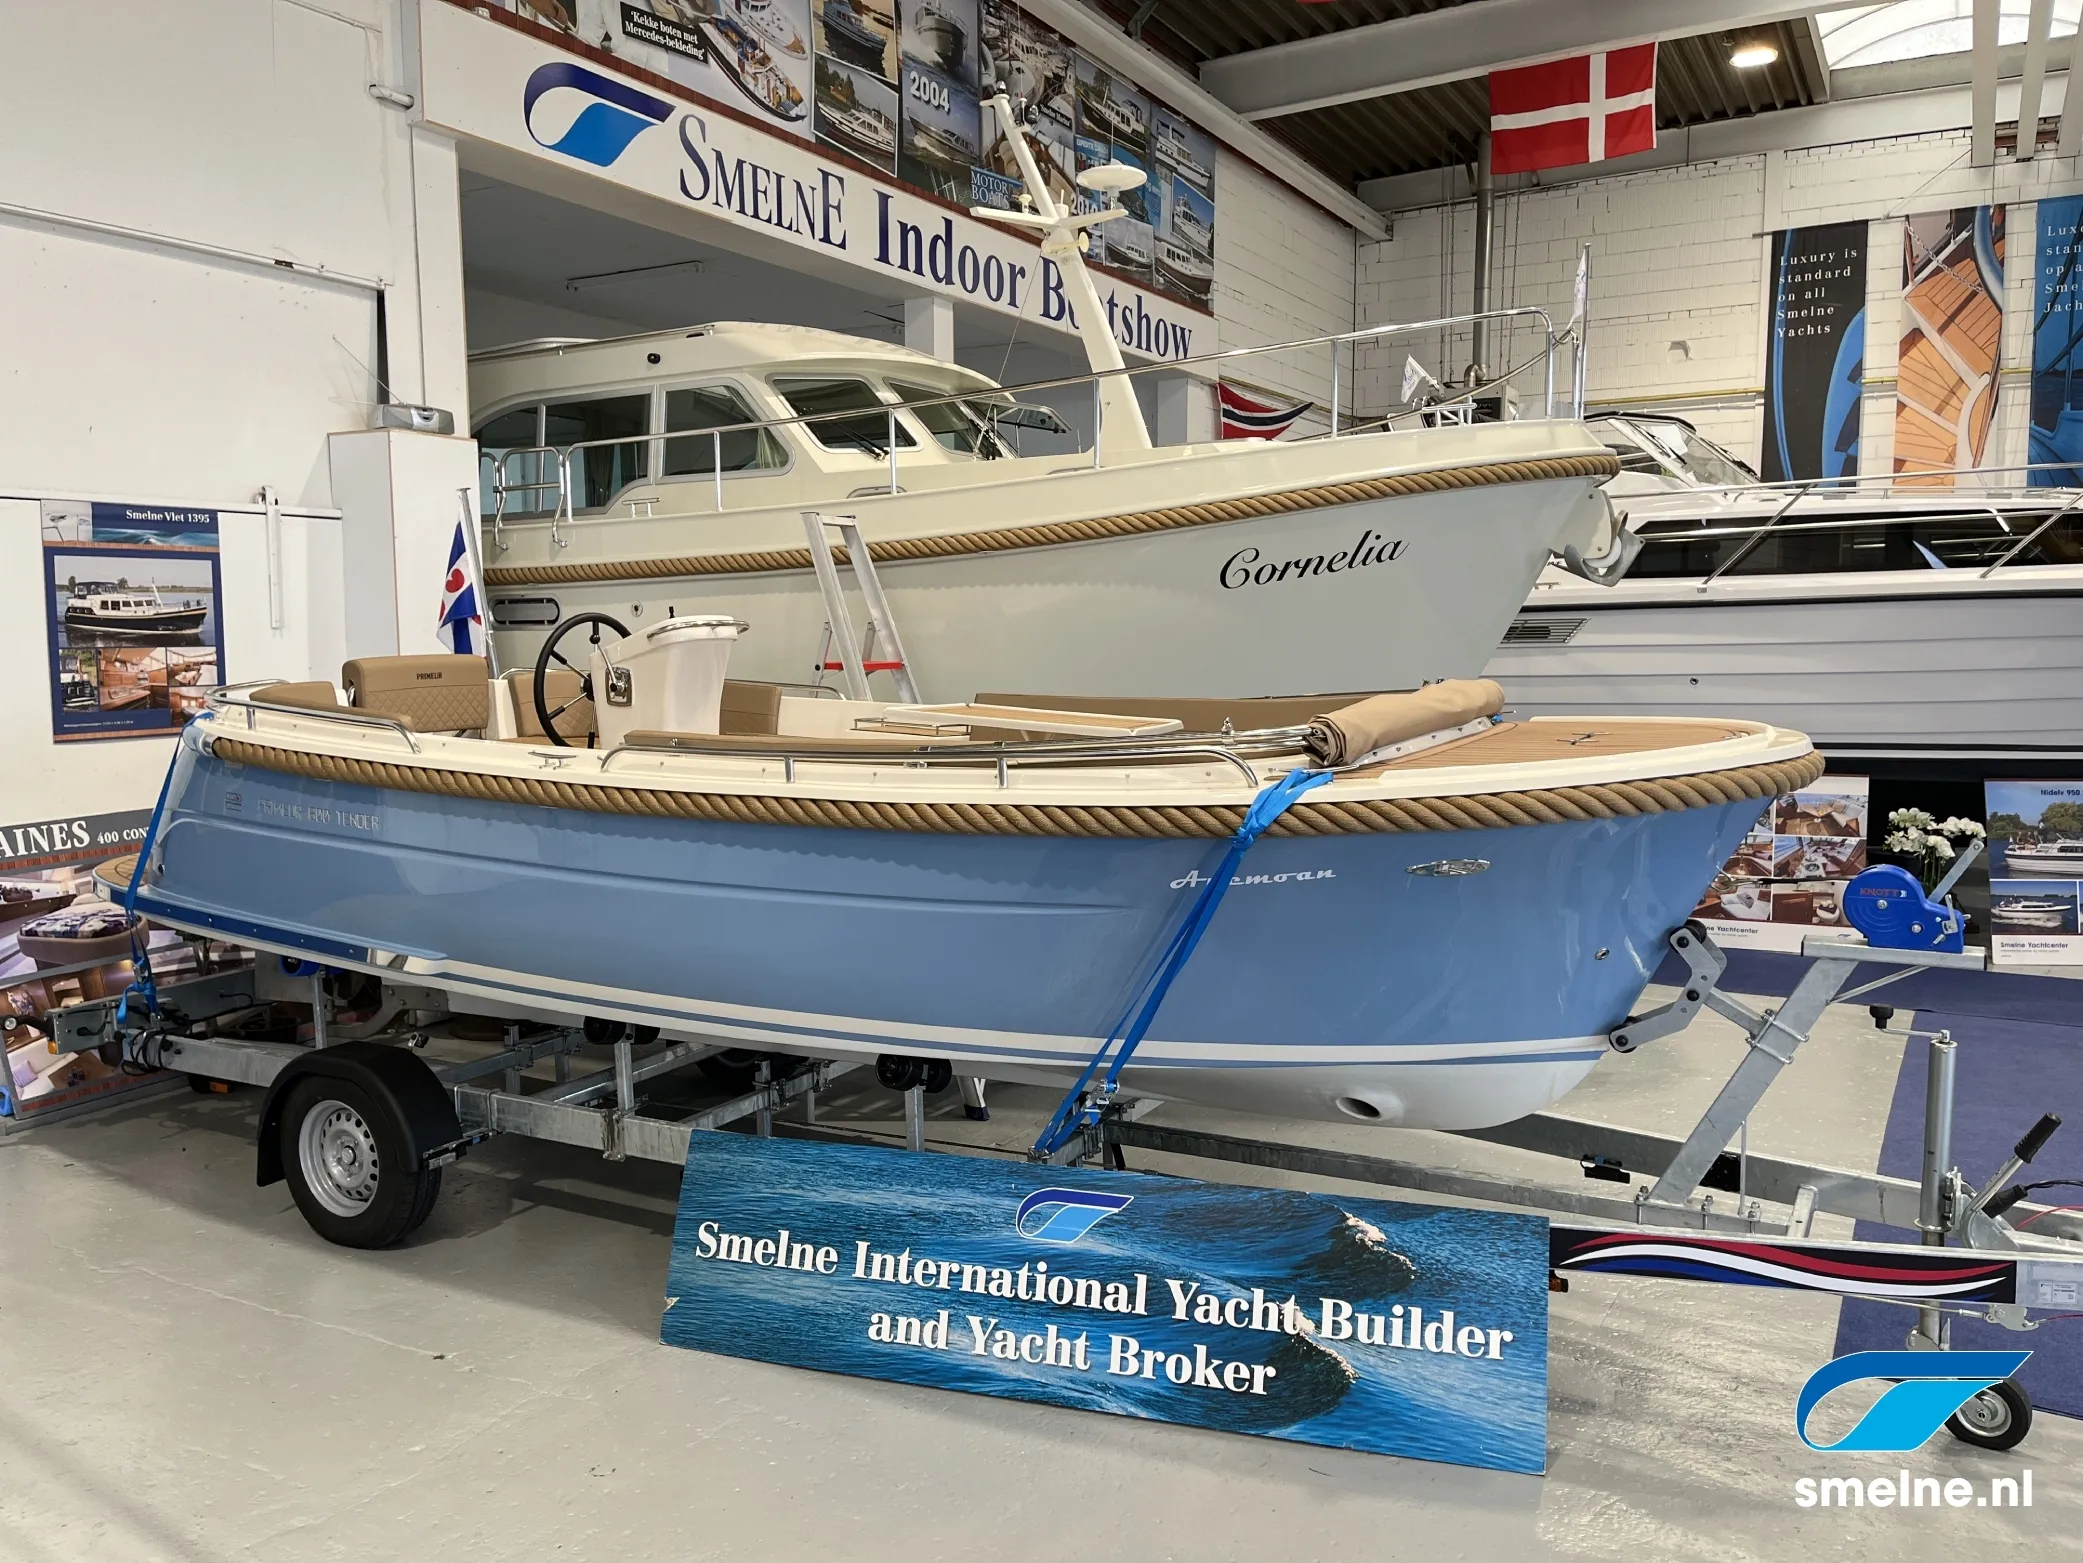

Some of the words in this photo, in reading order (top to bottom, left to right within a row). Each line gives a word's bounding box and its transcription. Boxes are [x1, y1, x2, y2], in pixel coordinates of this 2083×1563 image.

[660, 21, 682, 38] boten
[683, 31, 698, 44] met
[910, 71, 950, 112] 2004
[971, 171, 1008, 194] MOTOR
[972, 184, 1010, 210] BOATS
[1780, 252, 1836, 267] Luxury
[1844, 248, 1858, 259] is
[873, 189, 1026, 308] Indoor
[1039, 255, 1193, 361] Btshow
[1779, 266, 1851, 285] standard
[2045, 265, 2064, 277] op
[1778, 292, 1796, 302] on
[1804, 287, 1825, 300] all
[1777, 306, 1835, 321] Smelne
[1777, 324, 1831, 338] Yachts
[126, 509, 163, 521] Smelne
[164, 511, 185, 522] Vlet
[187, 513, 210, 524] 1395
[1219, 529, 1411, 590] Cornelia
[416, 671, 443, 680] PRIMEUR
[335, 810, 380, 831] TENDER
[97, 831, 119, 845] 400
[1859, 887, 1899, 897] KNOTT
[1717, 926, 1759, 934] Yachtcenter
[696, 1221, 838, 1275] Smelne
[851, 1240, 1147, 1316] International
[1164, 1278, 1301, 1336] Yacht
[1319, 1297, 1514, 1361] Builder
[867, 1310, 949, 1351] and
[966, 1315, 1091, 1372] Yacht
[1106, 1334, 1277, 1396] Broker
